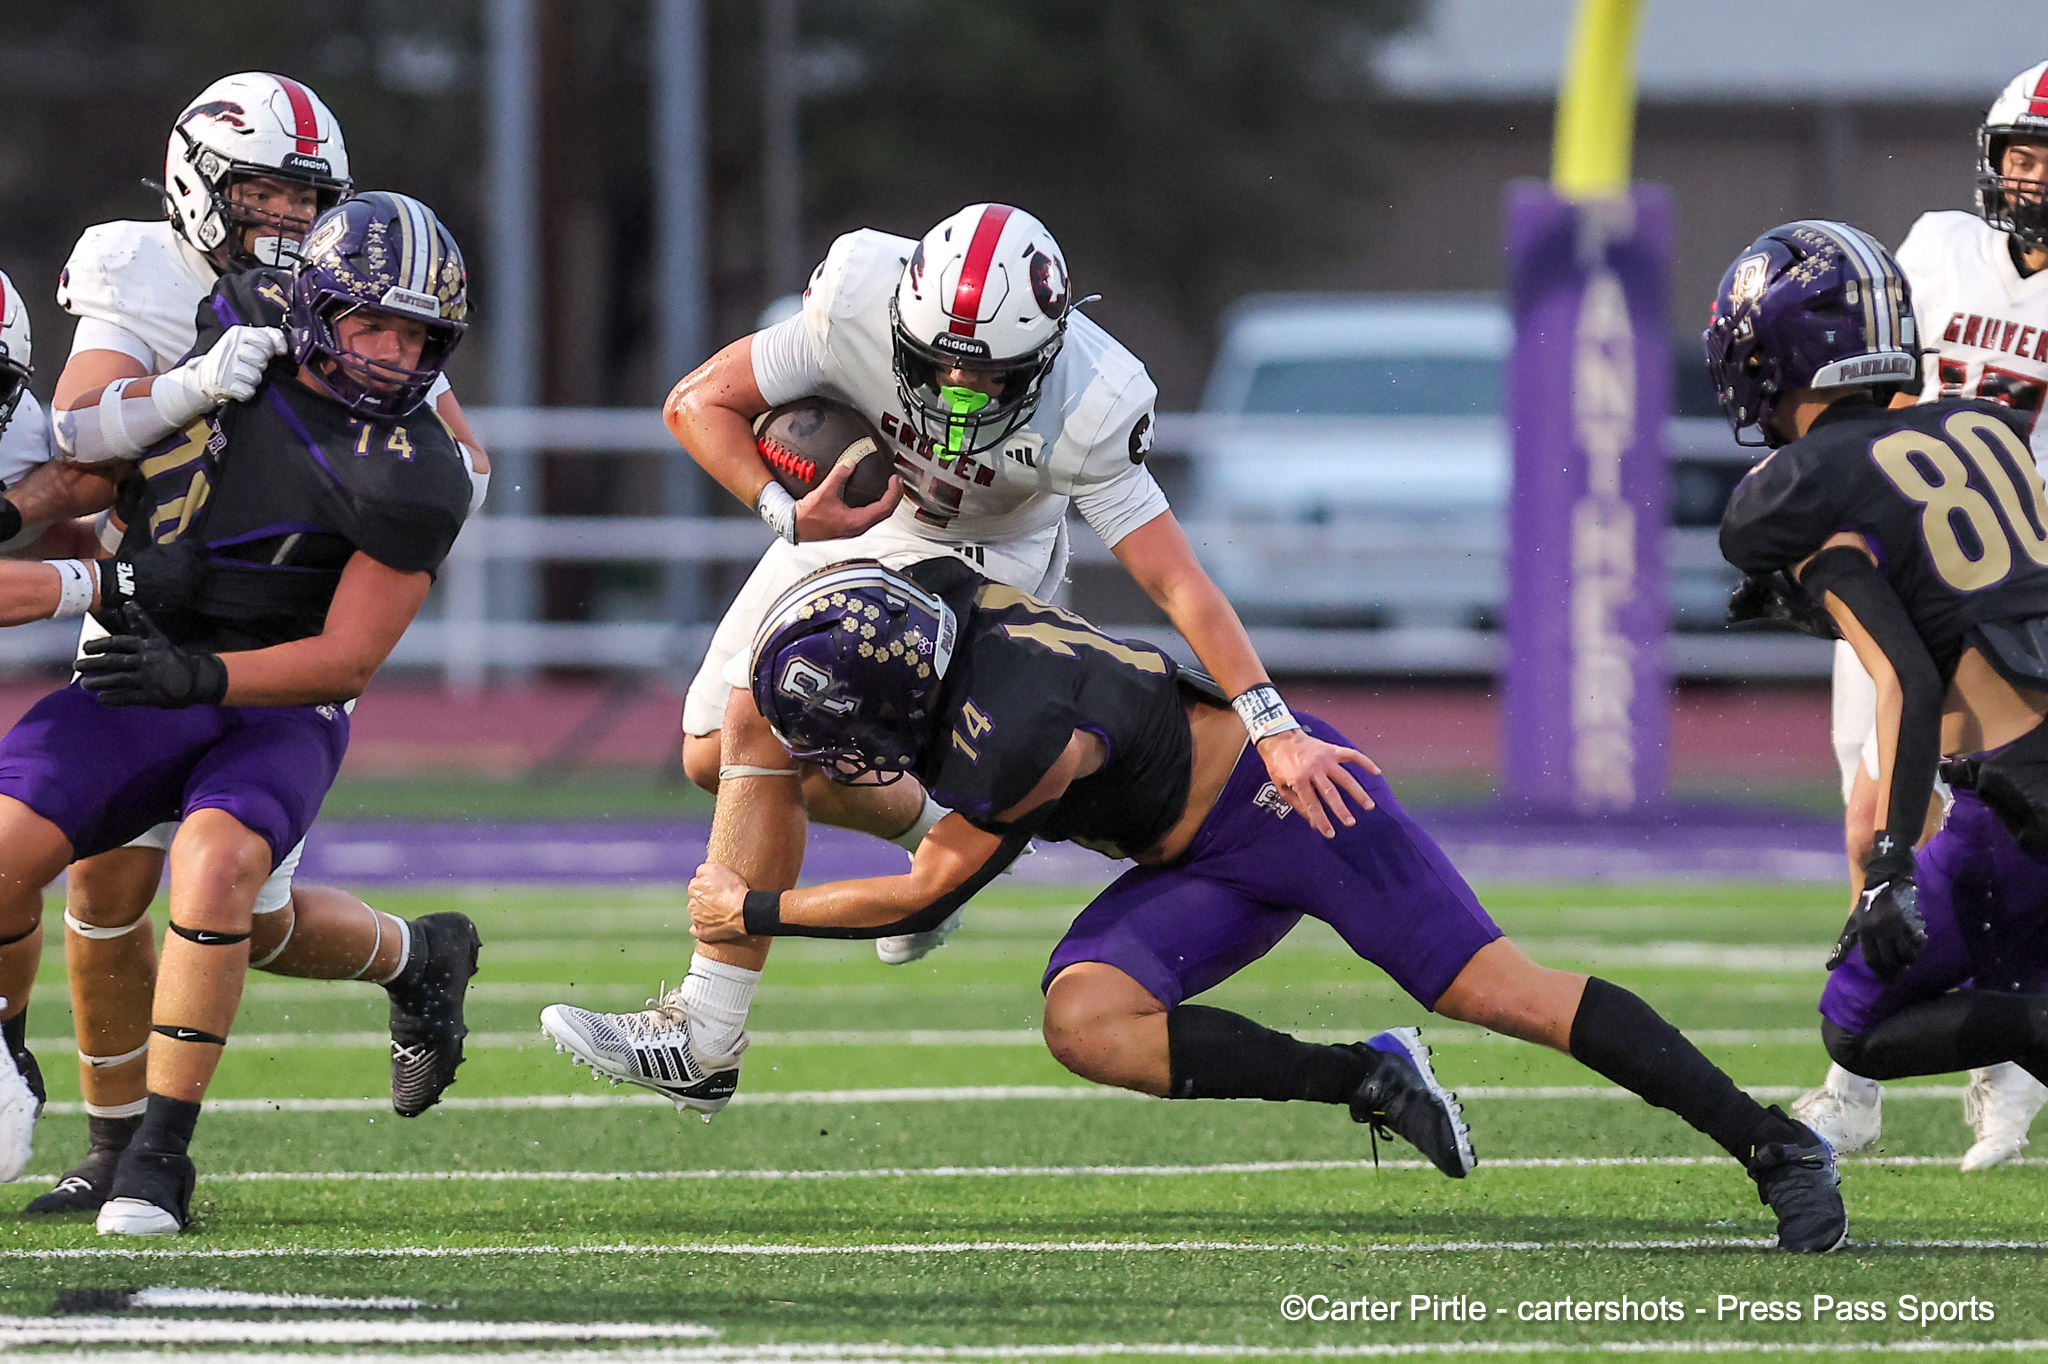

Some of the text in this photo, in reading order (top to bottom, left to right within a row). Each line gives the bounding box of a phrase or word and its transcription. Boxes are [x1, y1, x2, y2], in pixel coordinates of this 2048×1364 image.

[347, 416, 416, 462] 74
[1871, 409, 2048, 592] 80
[116, 561, 136, 597] NIKE
[951, 698, 996, 765] 14
